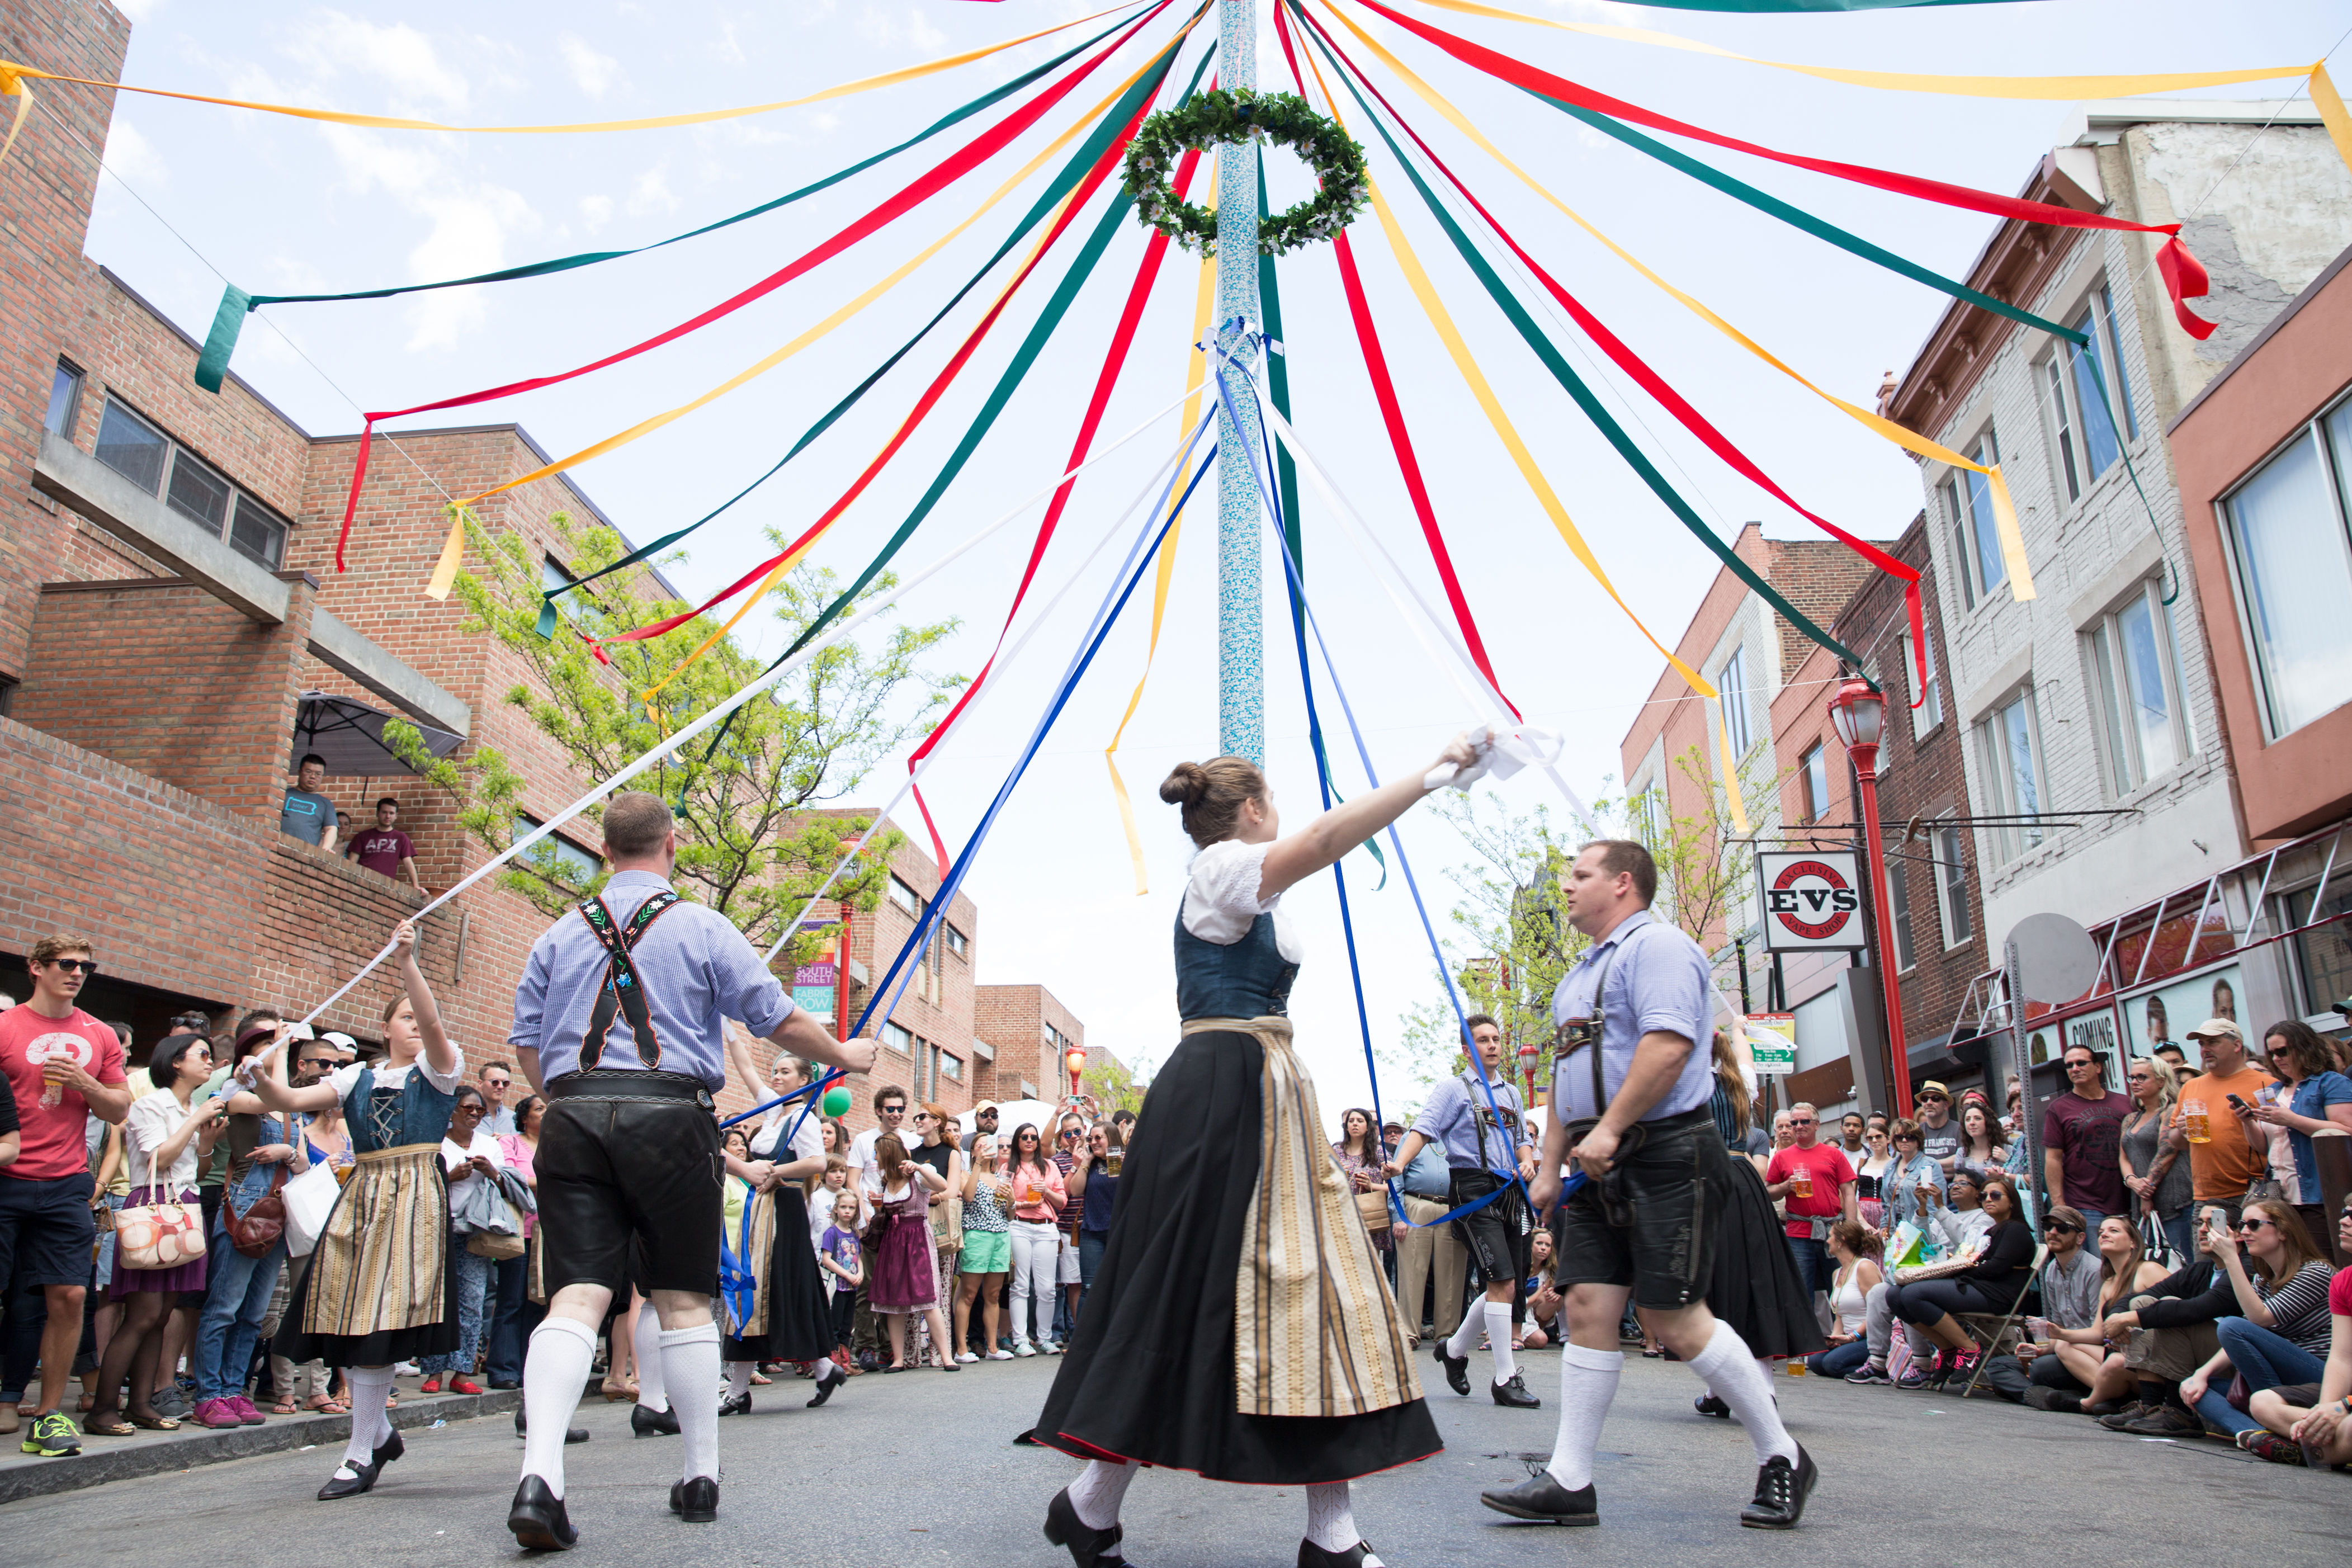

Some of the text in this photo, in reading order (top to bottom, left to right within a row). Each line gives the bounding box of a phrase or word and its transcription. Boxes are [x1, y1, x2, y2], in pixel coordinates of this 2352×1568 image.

[1780, 865, 1842, 886] EXCLUSIVE
[1768, 889, 1858, 912] EVS
[1787, 915, 1843, 935] VAPE SHOP
[796, 966, 833, 976] SOUTH
[796, 975, 832, 984] STREET
[795, 989, 830, 998] FABRIC
[2072, 1016, 2114, 1051] COMING
[1928, 1137, 1957, 1147] FRANCSCO
